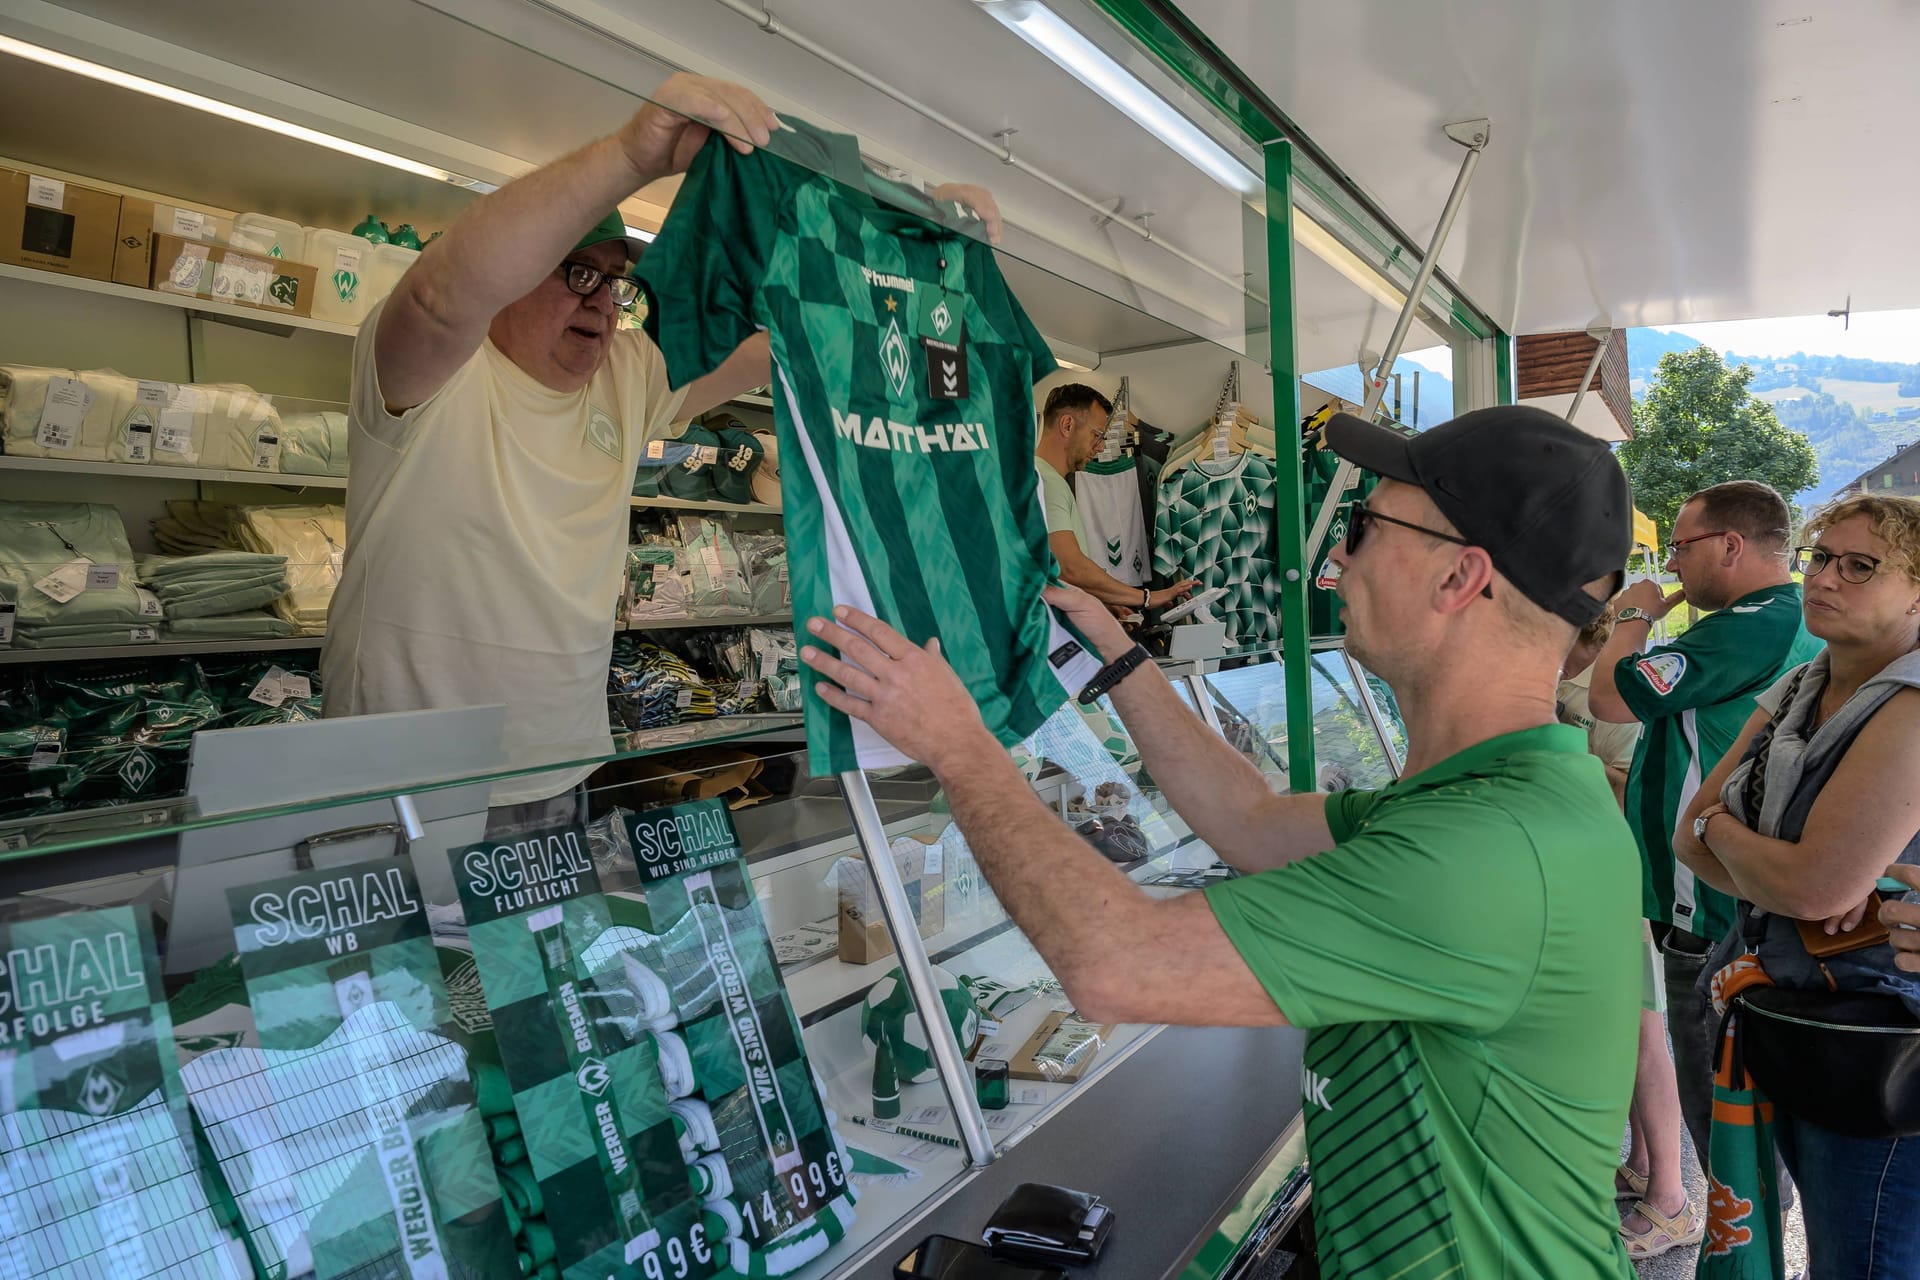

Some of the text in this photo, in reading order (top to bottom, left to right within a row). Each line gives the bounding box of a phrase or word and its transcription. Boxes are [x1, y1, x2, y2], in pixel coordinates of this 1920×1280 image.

[872, 270, 915, 293] hummel
[830, 406, 990, 454] MATTHÄI
[728, 456, 748, 472] 99
[635, 808, 735, 863] SCHAL
[464, 832, 592, 897] SCHAL
[648, 848, 737, 879] WIR SIND WERDER
[249, 868, 419, 948] SCHAL
[494, 877, 581, 914] FLUTLICHT
[324, 931, 360, 957] WB
[559, 980, 593, 1054] BREMEN
[737, 1015, 764, 1063] SIND
[752, 1063, 776, 1106] WIR
[594, 1100, 629, 1176] WERDER
[400, 1152, 436, 1263] WERDER
[609, 1222, 712, 1280] 99€
